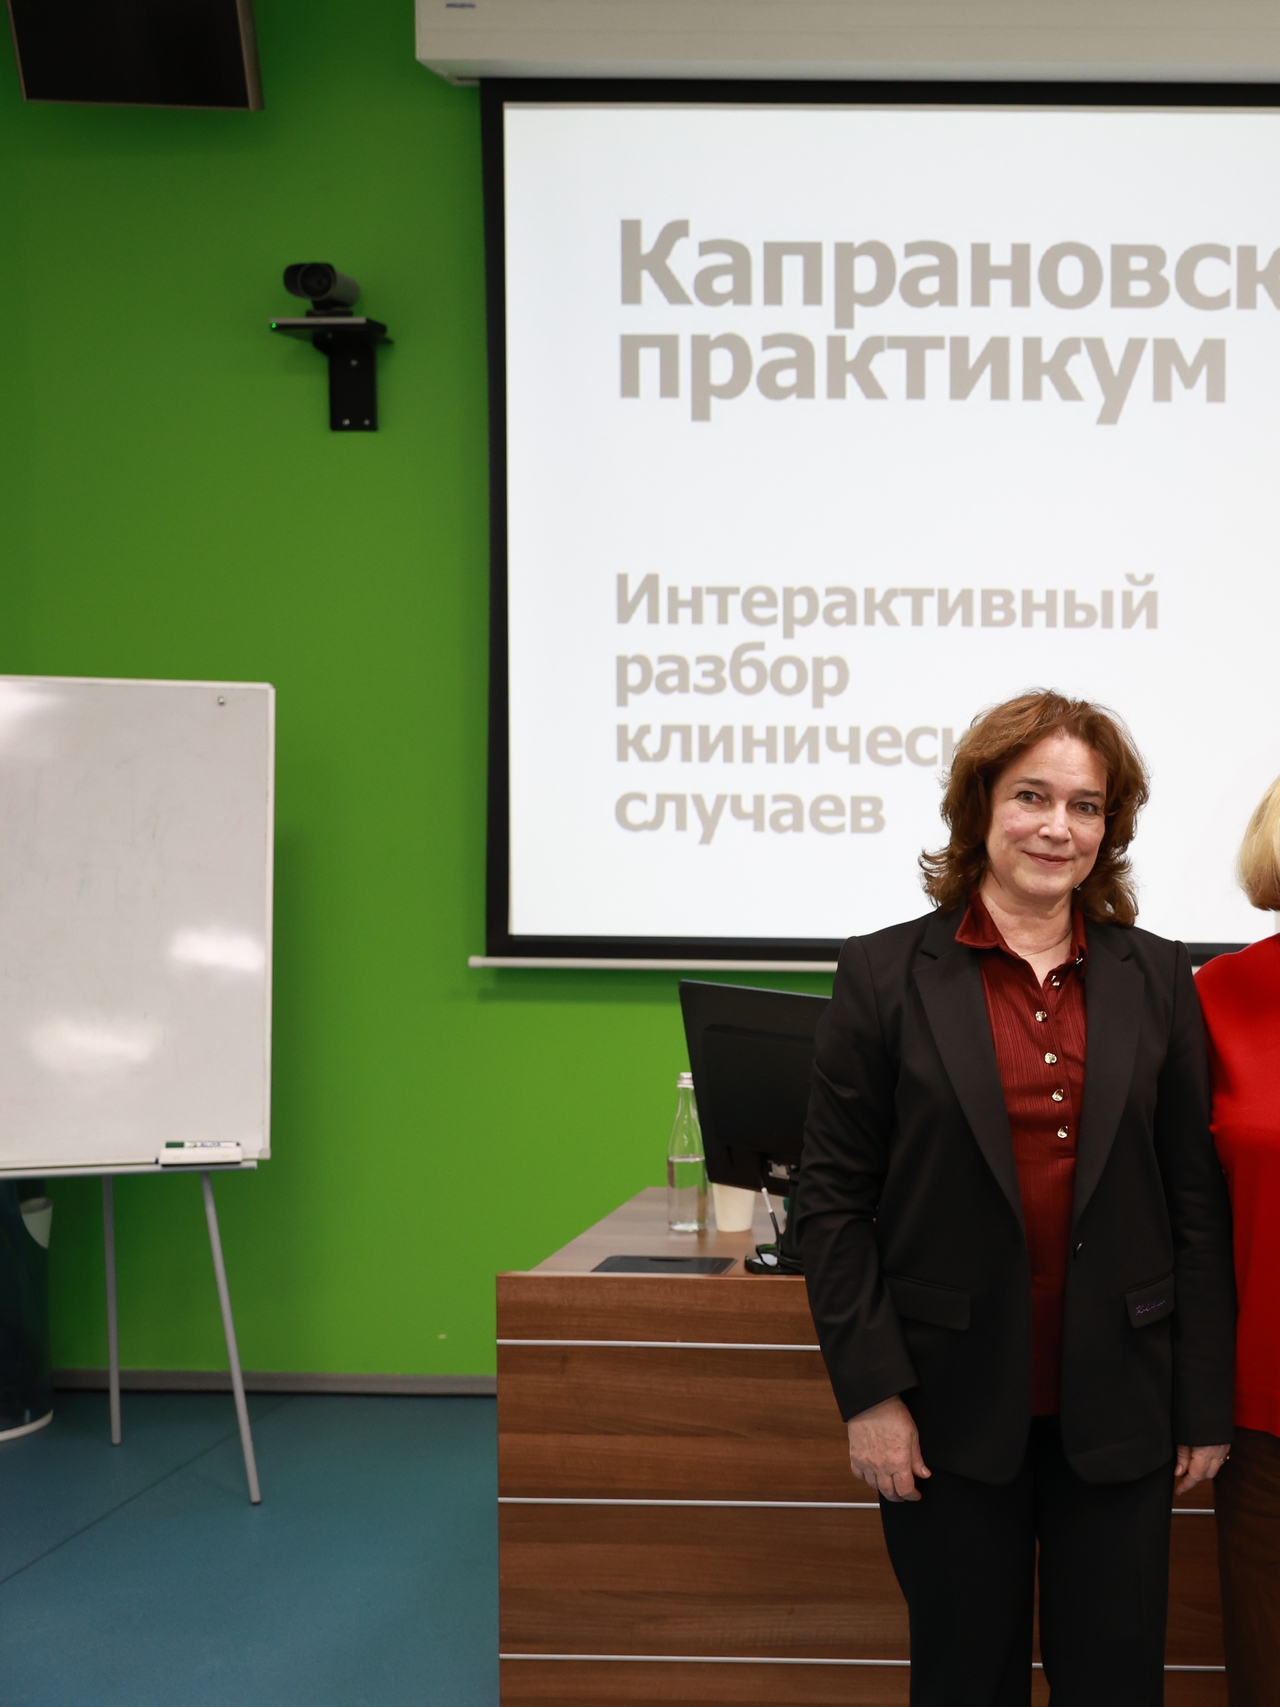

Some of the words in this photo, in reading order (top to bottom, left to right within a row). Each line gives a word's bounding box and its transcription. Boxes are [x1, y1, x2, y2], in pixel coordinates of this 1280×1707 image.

[619, 332, 1227, 425] практикум
[616, 572, 1159, 639] Интерактивный
[616, 641, 850, 708] разбор
[614, 790, 887, 845] случаев
